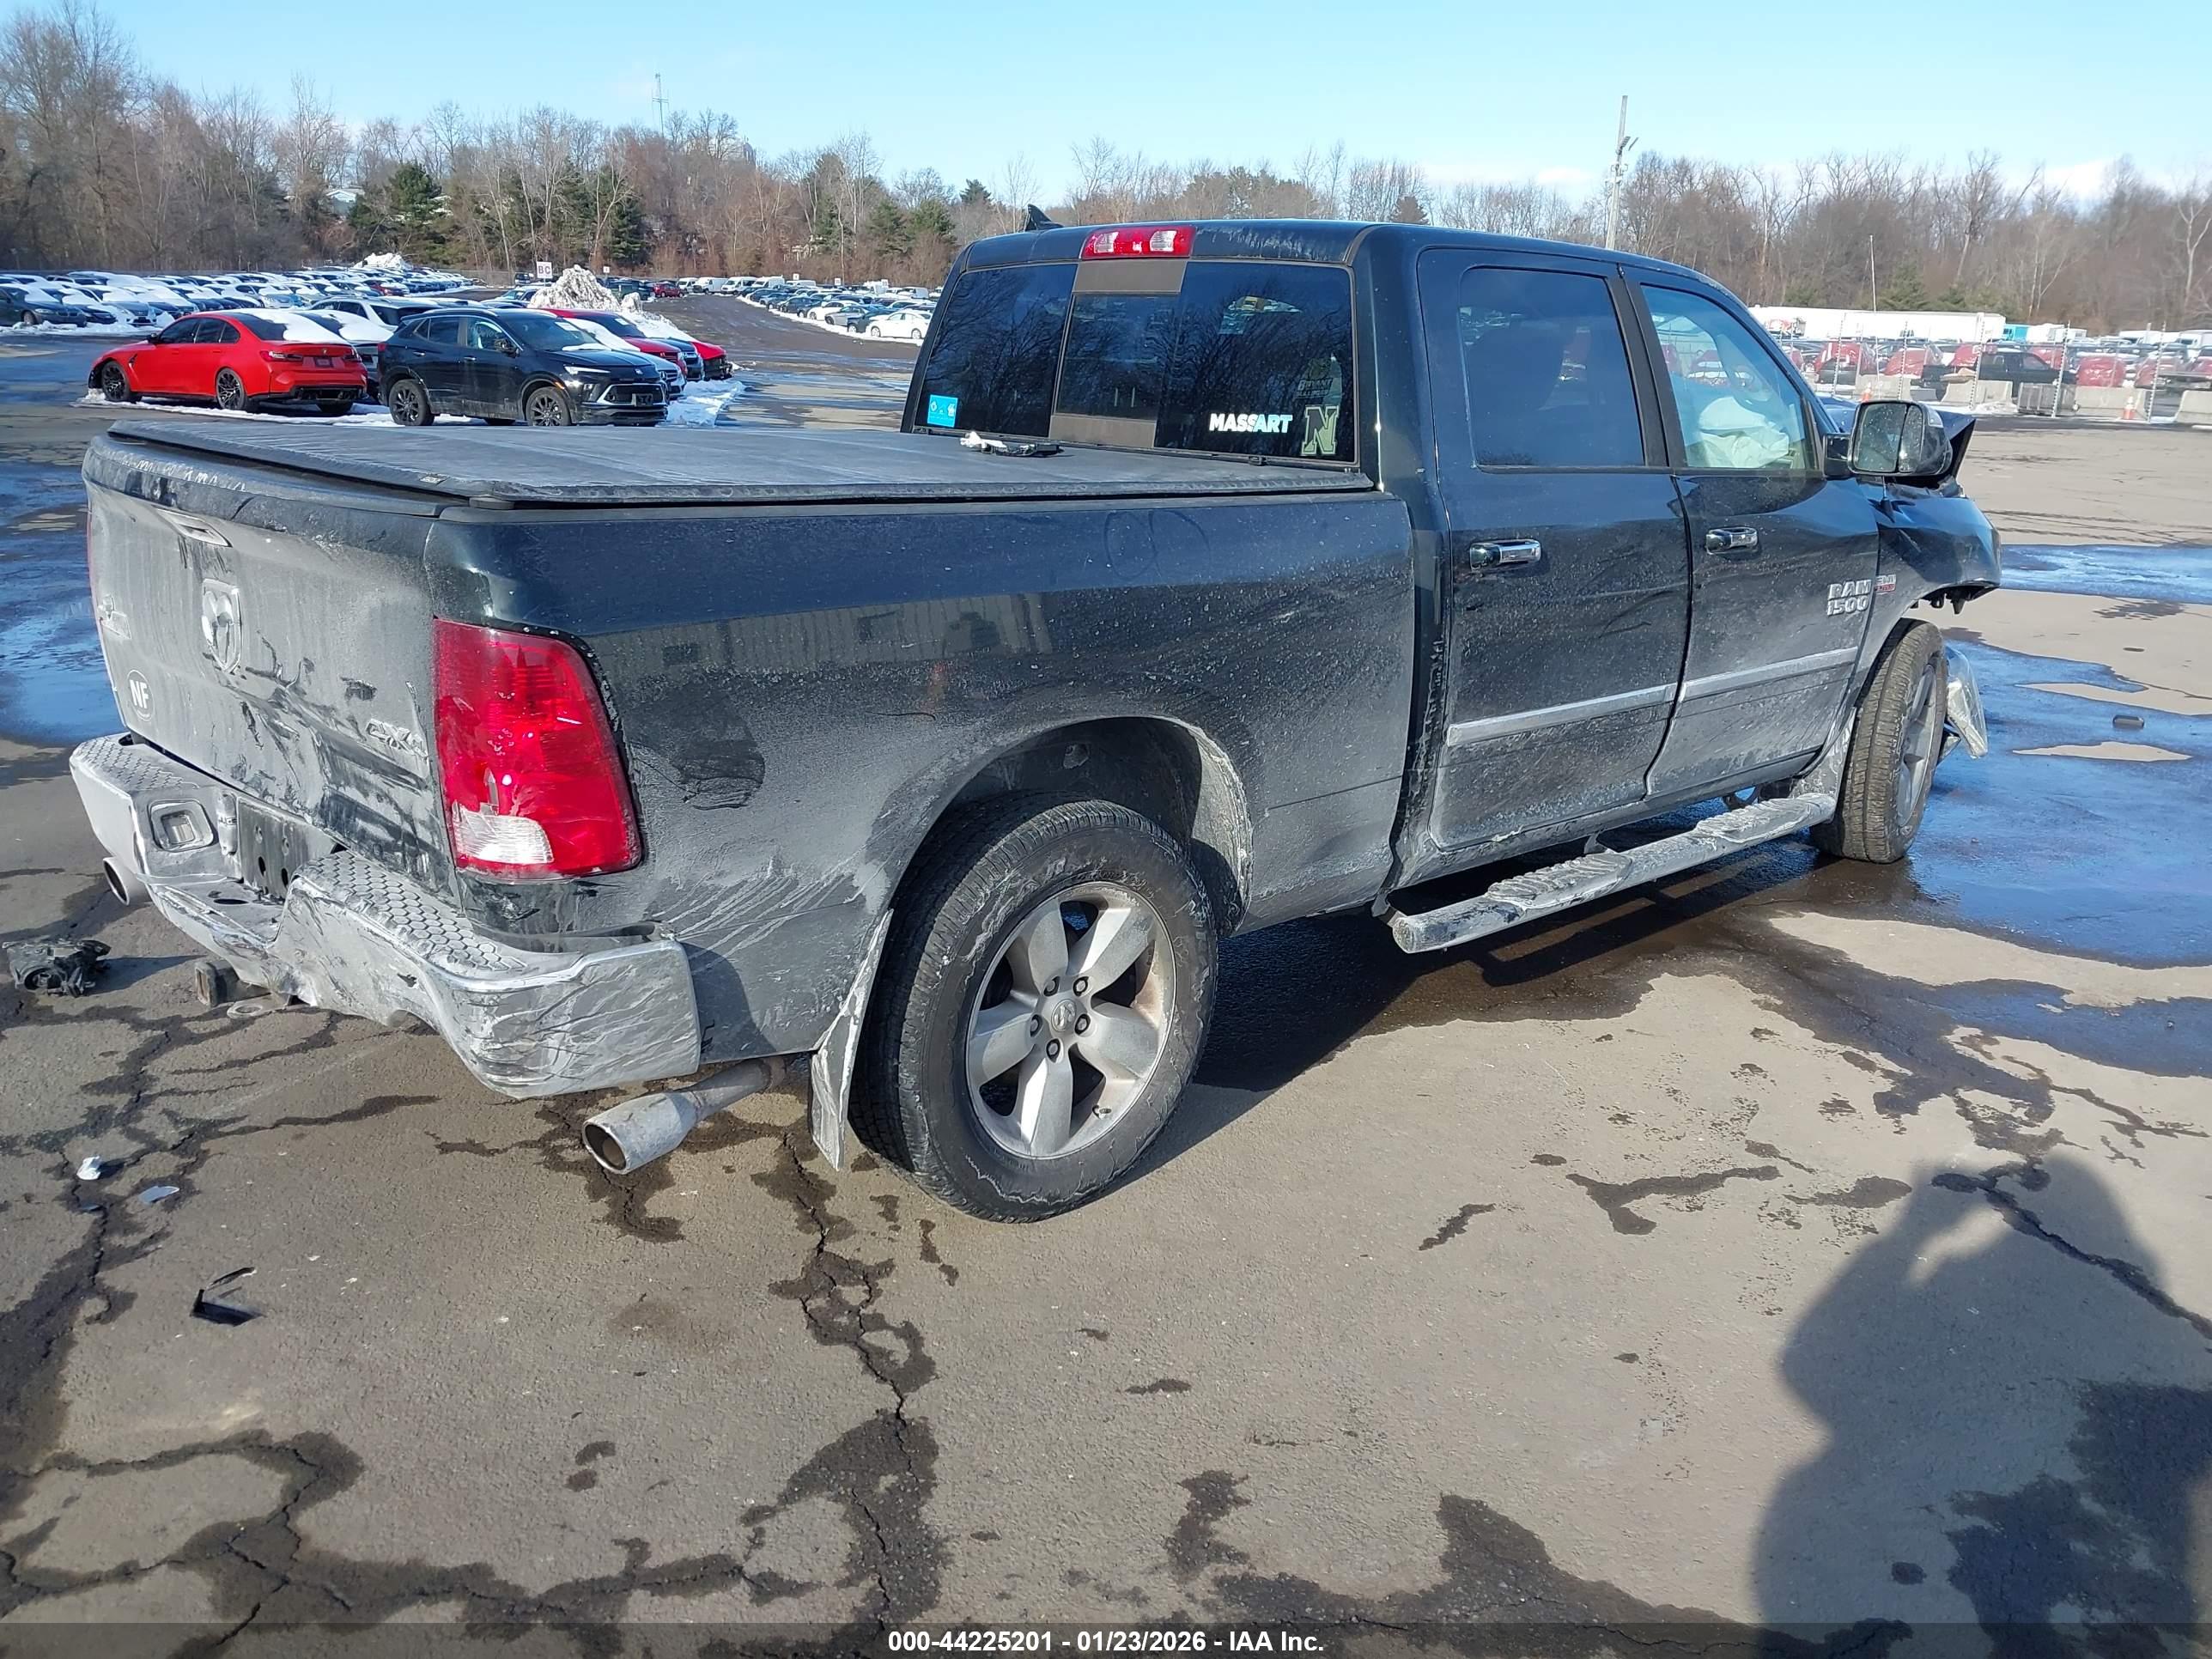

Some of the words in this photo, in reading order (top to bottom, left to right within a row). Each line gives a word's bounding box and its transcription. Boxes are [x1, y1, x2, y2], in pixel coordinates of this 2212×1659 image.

[538, 265, 551, 275] BC
[1209, 413, 1293, 433] MASSART
[1301, 405, 1340, 456] N
[1826, 580, 1872, 600] RAM
[1826, 595, 1869, 617] 1500
[129, 679, 149, 709] NF
